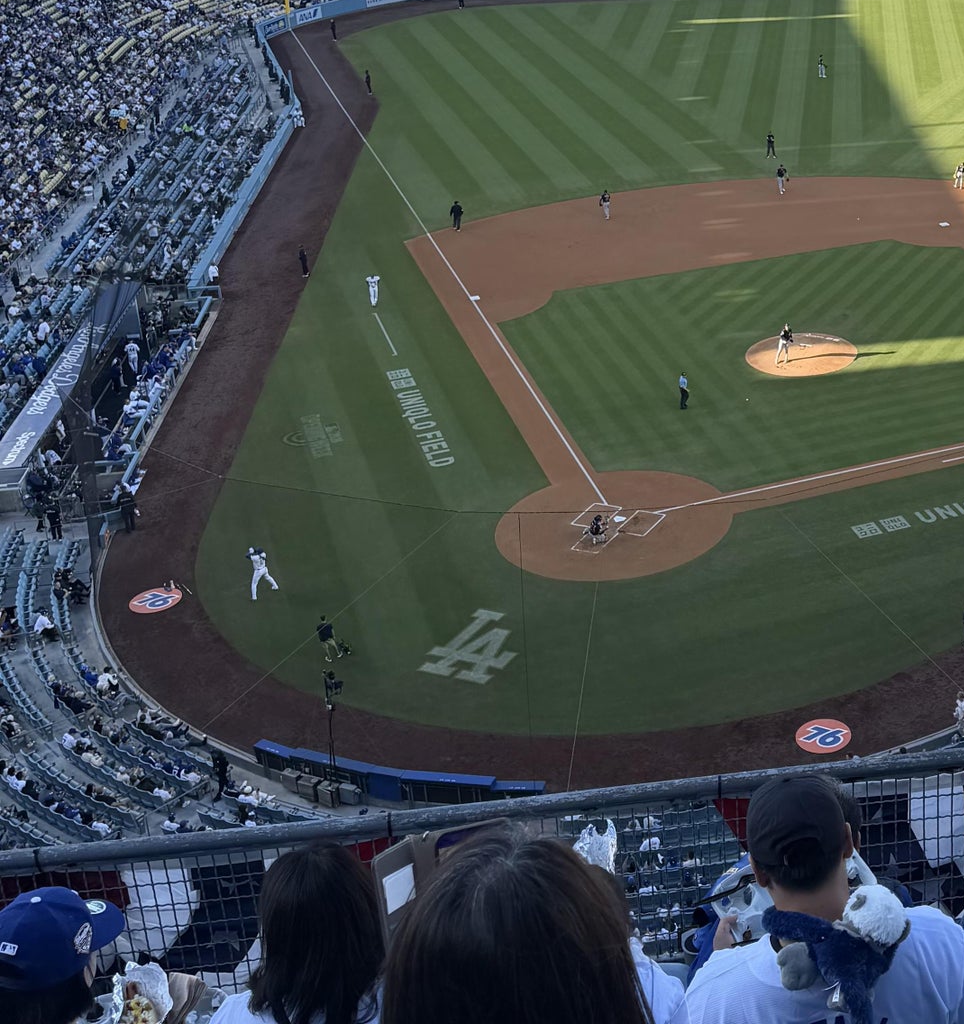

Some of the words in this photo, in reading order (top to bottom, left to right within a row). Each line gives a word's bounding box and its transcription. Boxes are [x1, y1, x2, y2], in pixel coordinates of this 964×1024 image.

[396, 388, 437, 430] UNIQLO
[2, 431, 36, 466] Spectrum
[416, 430, 455, 467] FIELD
[132, 592, 180, 610] 76
[416, 608, 520, 685] LA
[799, 724, 848, 748] 76
